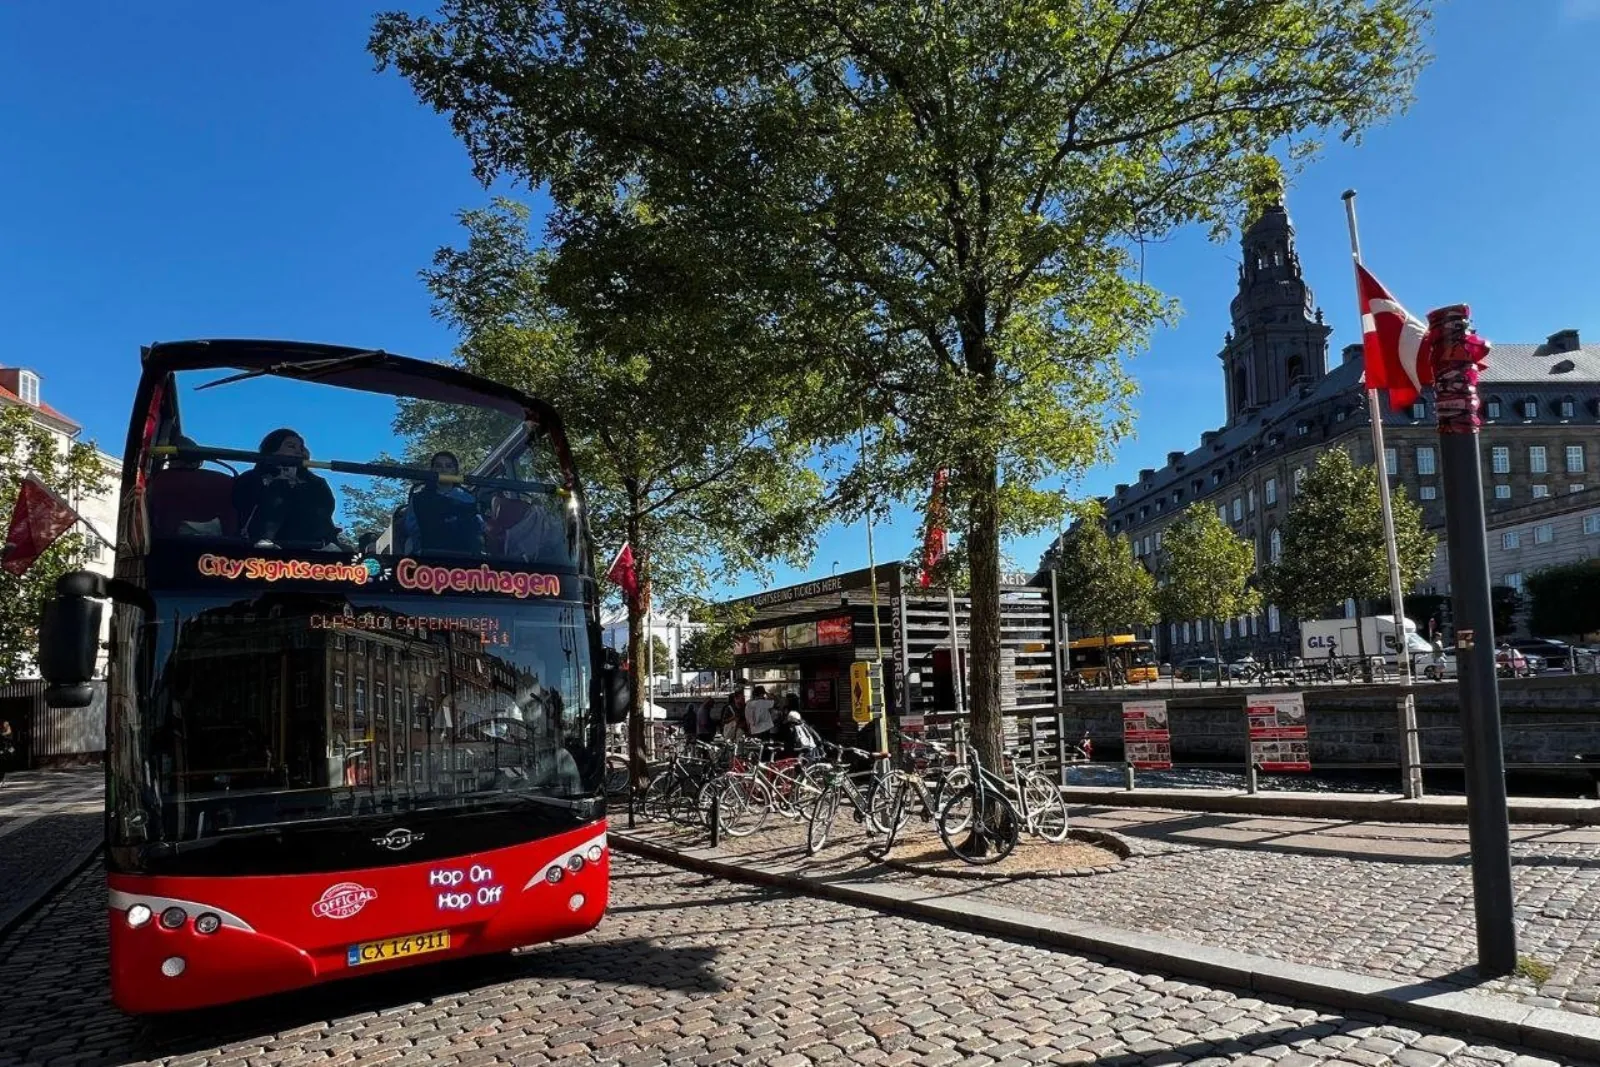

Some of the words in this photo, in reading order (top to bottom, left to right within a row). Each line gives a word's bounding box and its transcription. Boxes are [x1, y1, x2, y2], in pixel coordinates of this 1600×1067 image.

[396, 557, 561, 599] Copenhagen
[1000, 572, 1026, 586] KETS
[754, 588, 792, 606] SIGHTSEENG
[794, 582, 821, 597] TICKETS
[821, 577, 842, 592] HERE
[395, 616, 500, 631] COPENHAGEN
[891, 596, 904, 690] BROCHURES
[1307, 635, 1336, 649] GLS
[430, 870, 464, 886] Hop
[470, 865, 492, 883] On
[319, 890, 374, 913] OFFICIAL
[438, 892, 472, 909] Hop
[477, 885, 504, 904] Off
[362, 942, 386, 960] CX
[392, 938, 411, 955] 14
[416, 933, 445, 951] 911
